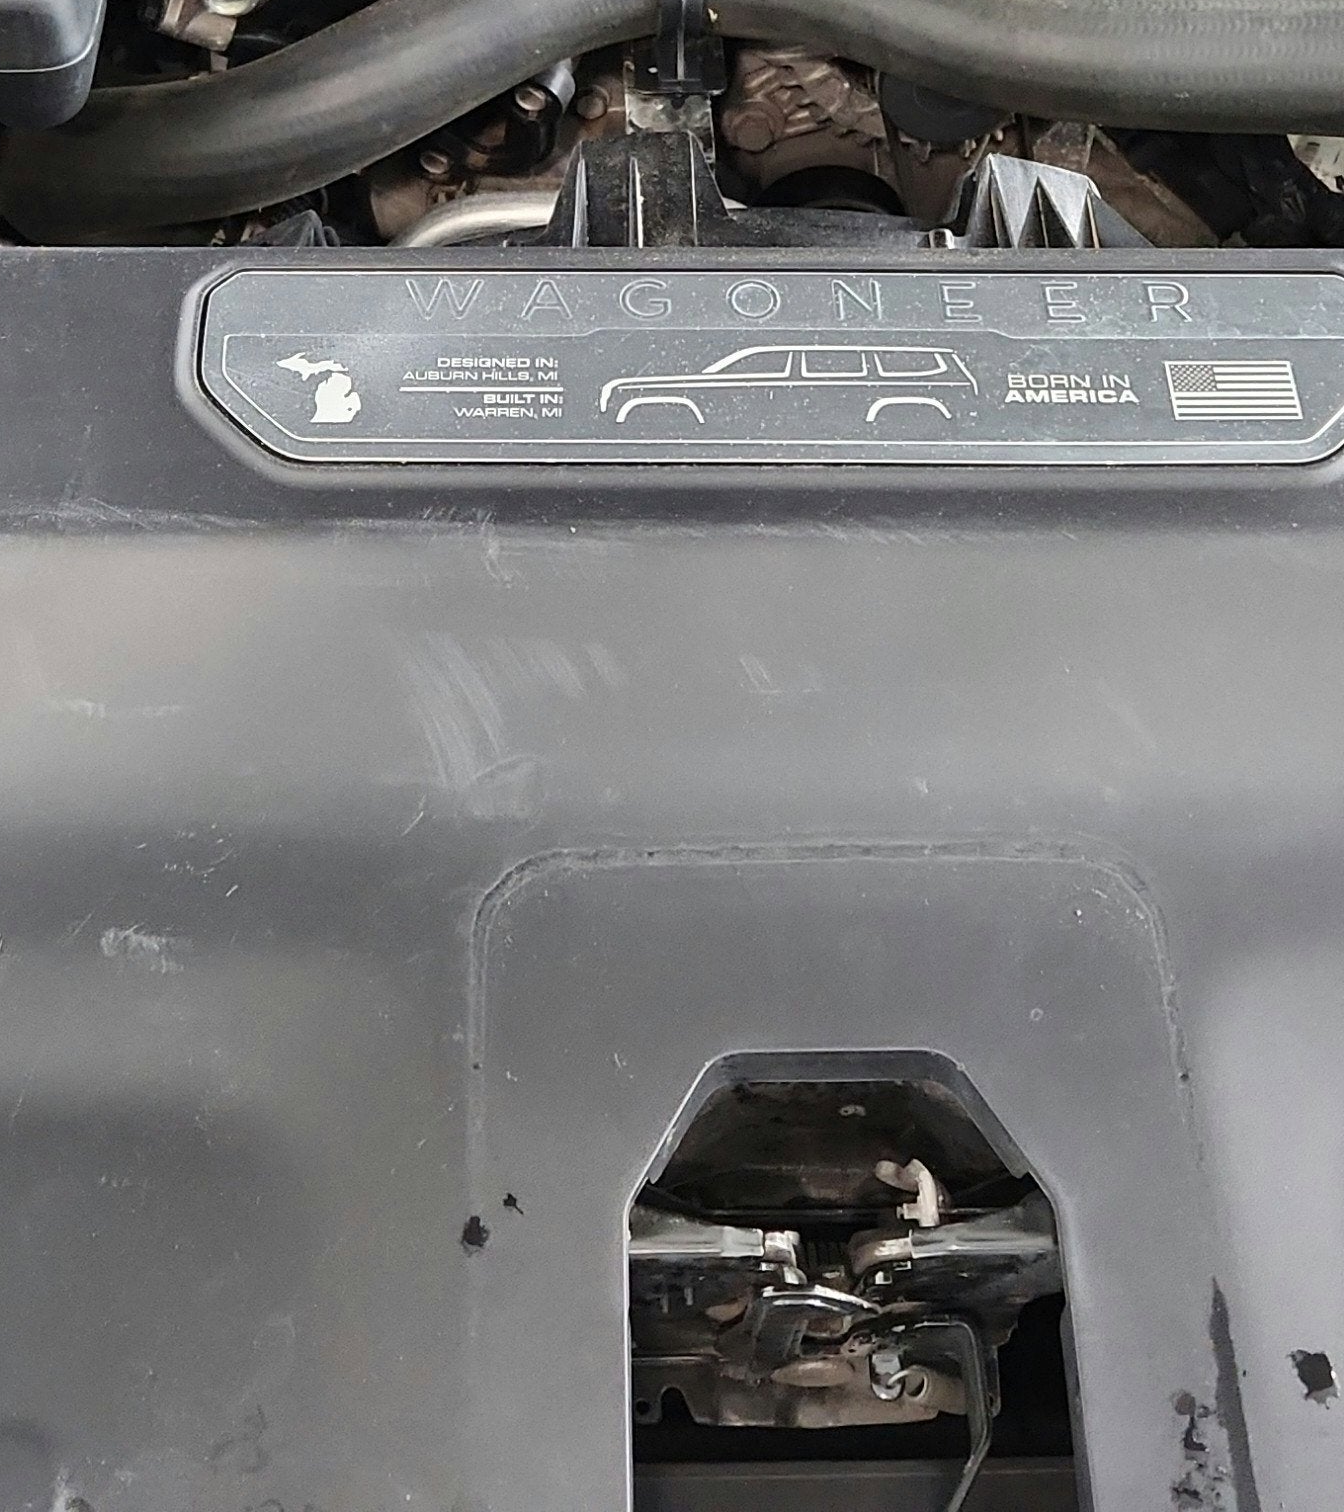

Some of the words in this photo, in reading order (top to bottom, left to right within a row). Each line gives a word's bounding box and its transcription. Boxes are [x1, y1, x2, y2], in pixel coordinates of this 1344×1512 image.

[404, 278, 1193, 323] WAGONEER
[437, 356, 532, 369] DESIGNED
[535, 357, 559, 369] IN:
[402, 370, 480, 381] AUBURN
[482, 370, 535, 383] HILLS,
[538, 370, 559, 381] MI
[1007, 374, 1089, 388] BORN
[1102, 374, 1130, 388] IN
[483, 393, 538, 405] BUILT
[540, 394, 564, 405] IN:
[1003, 389, 1140, 403] AMERICA
[454, 408, 538, 419] WARREN,
[541, 408, 563, 418] MI
